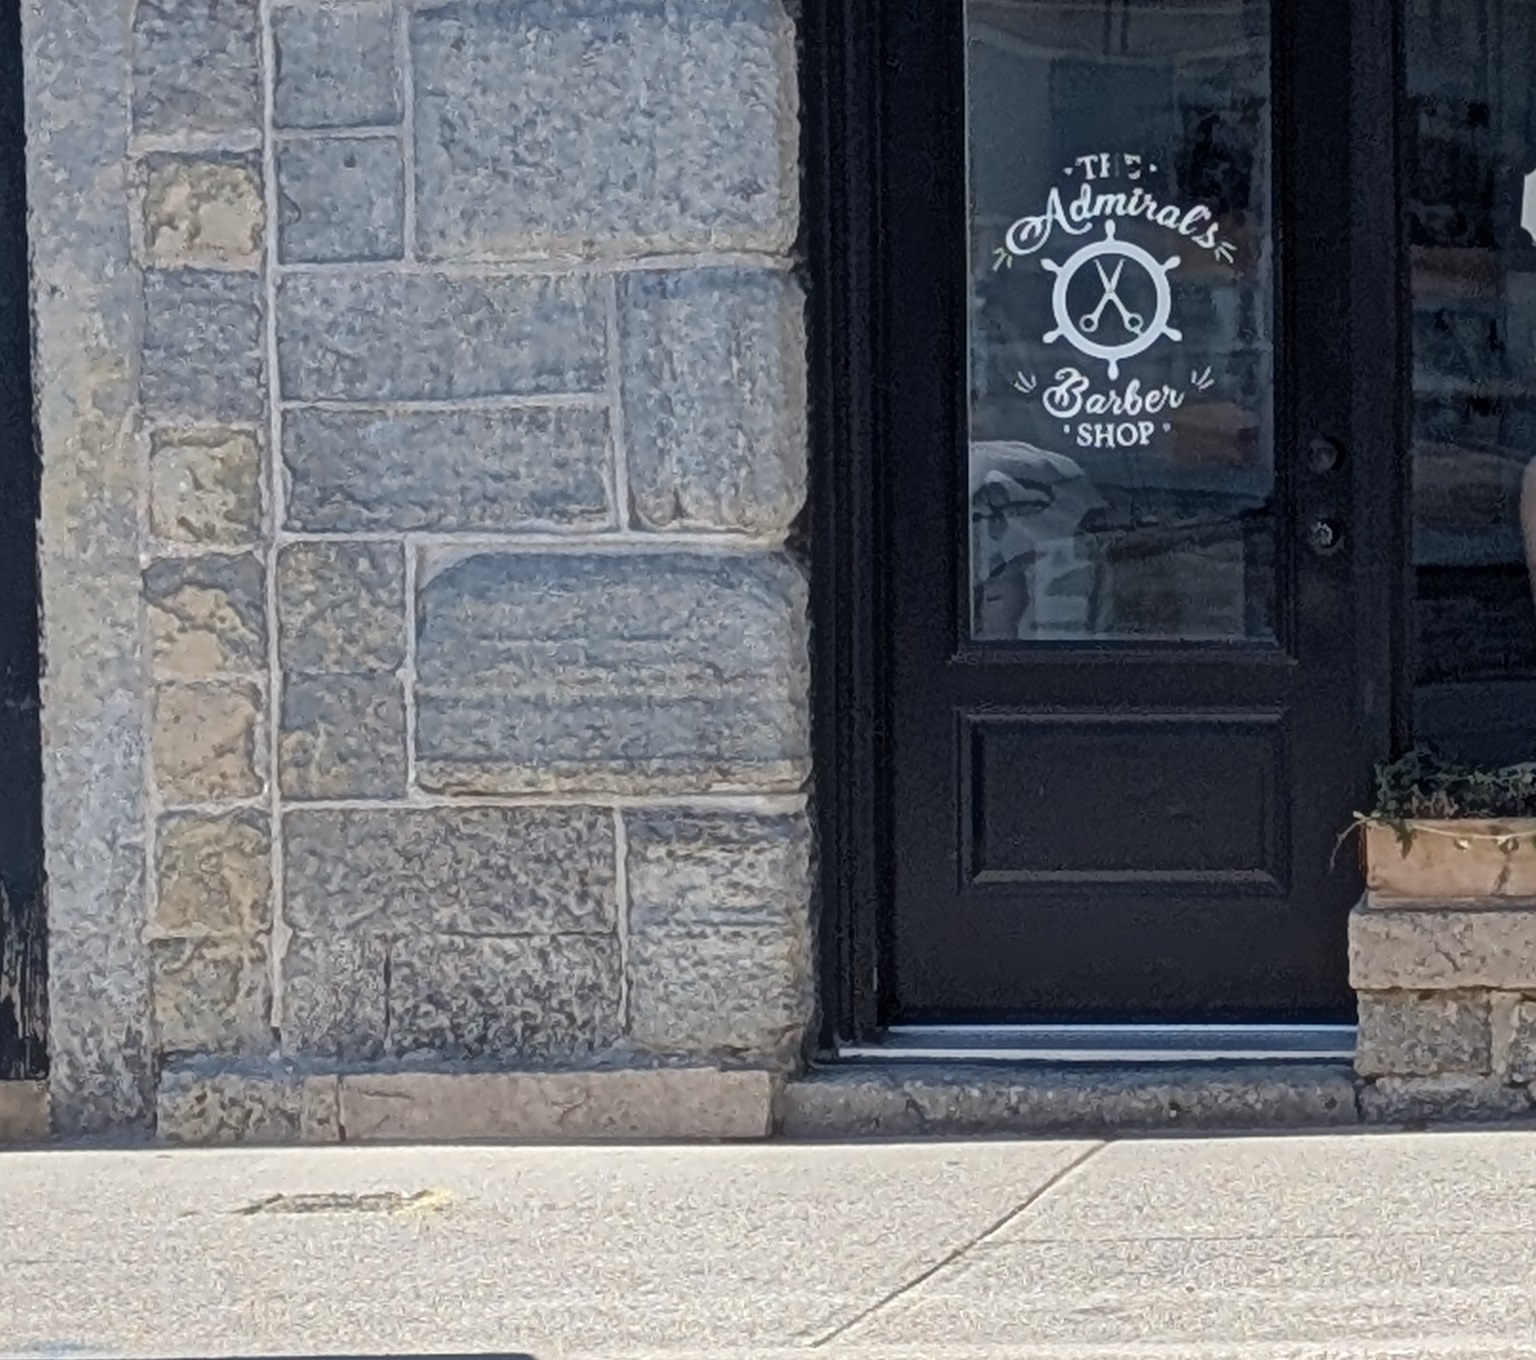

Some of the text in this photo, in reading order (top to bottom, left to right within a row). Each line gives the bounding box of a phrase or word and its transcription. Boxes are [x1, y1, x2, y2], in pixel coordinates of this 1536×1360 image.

[1006, 183, 1219, 255] Admiral's
[1043, 367, 1184, 418] Barber
[1077, 421, 1155, 448] SHOP
